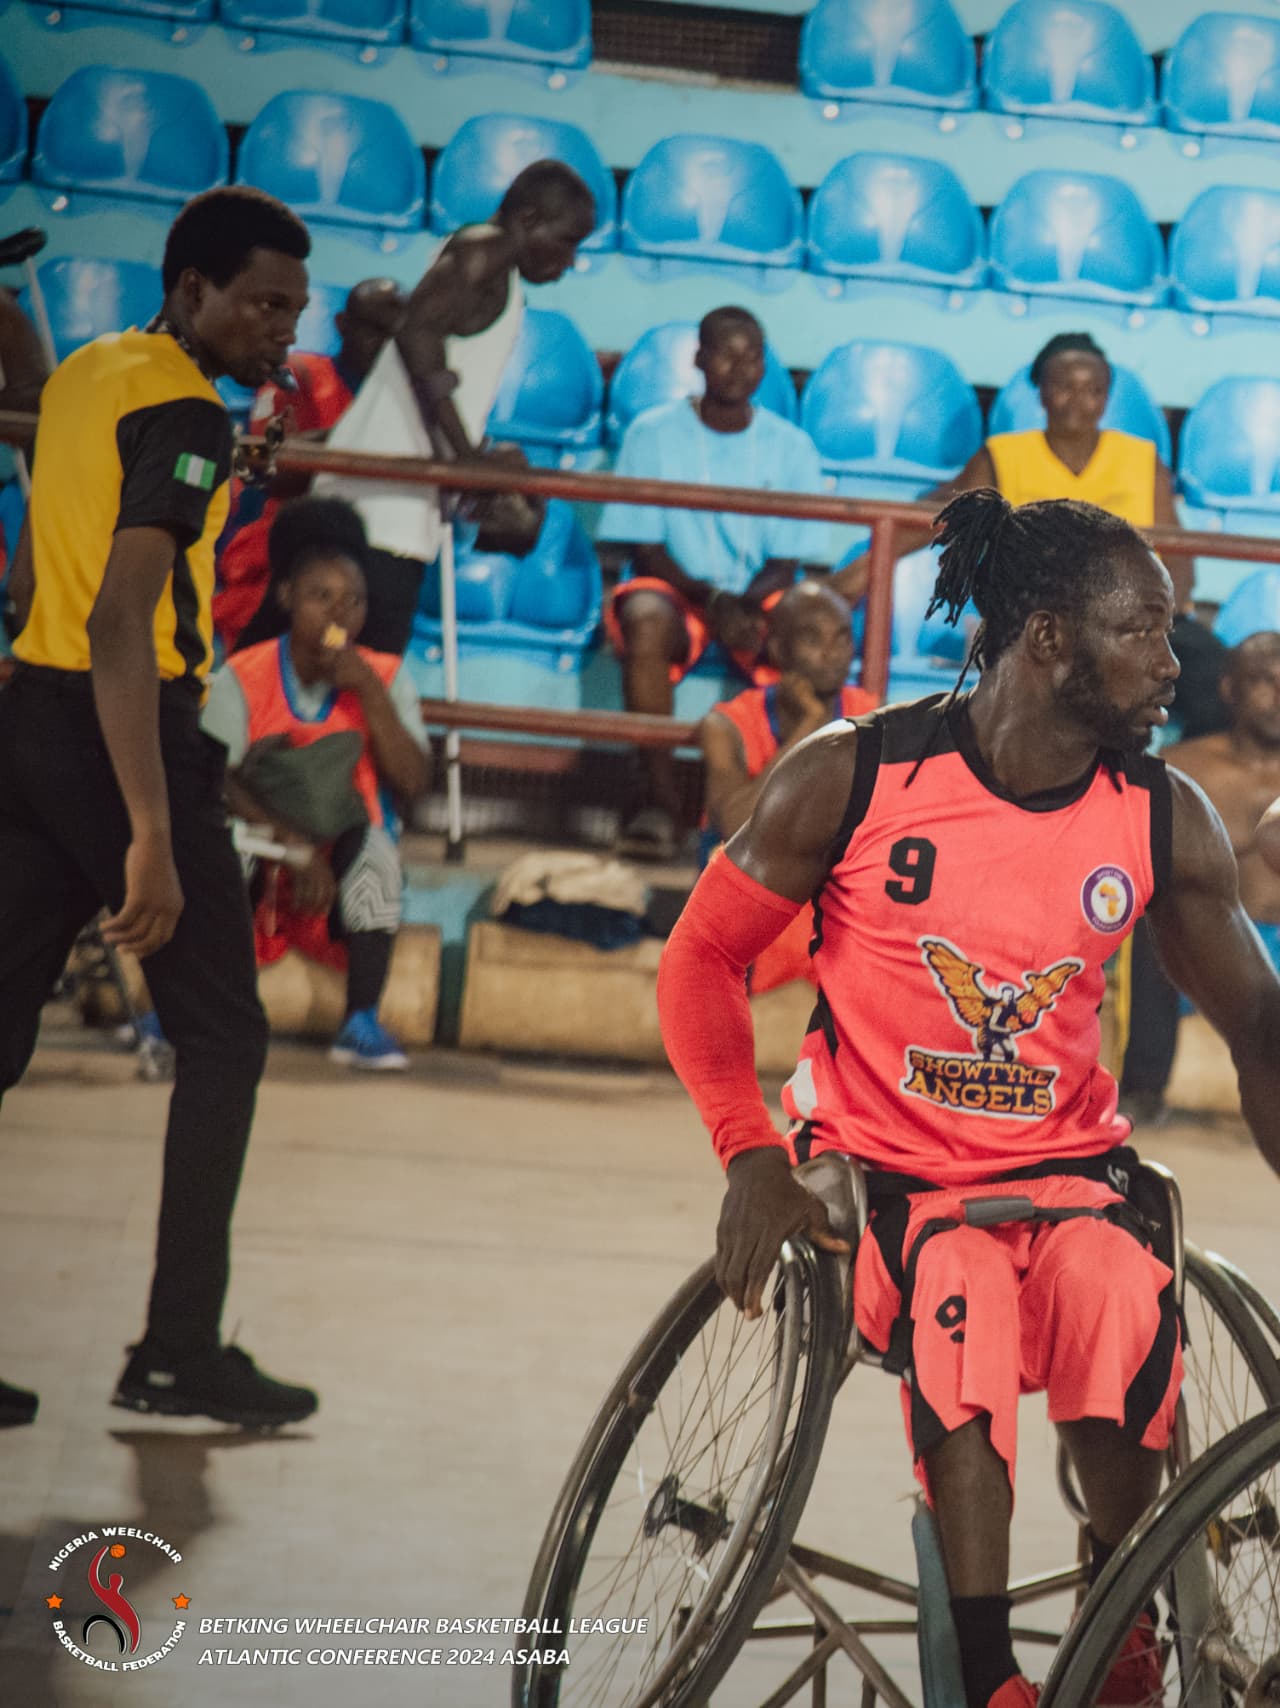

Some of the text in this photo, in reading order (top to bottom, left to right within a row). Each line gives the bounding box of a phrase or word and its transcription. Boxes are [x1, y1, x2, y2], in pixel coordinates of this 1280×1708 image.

[885, 836, 937, 905] 9
[910, 1051, 1056, 1086] SHOWTYME
[904, 1069, 1052, 1115] ANGELS
